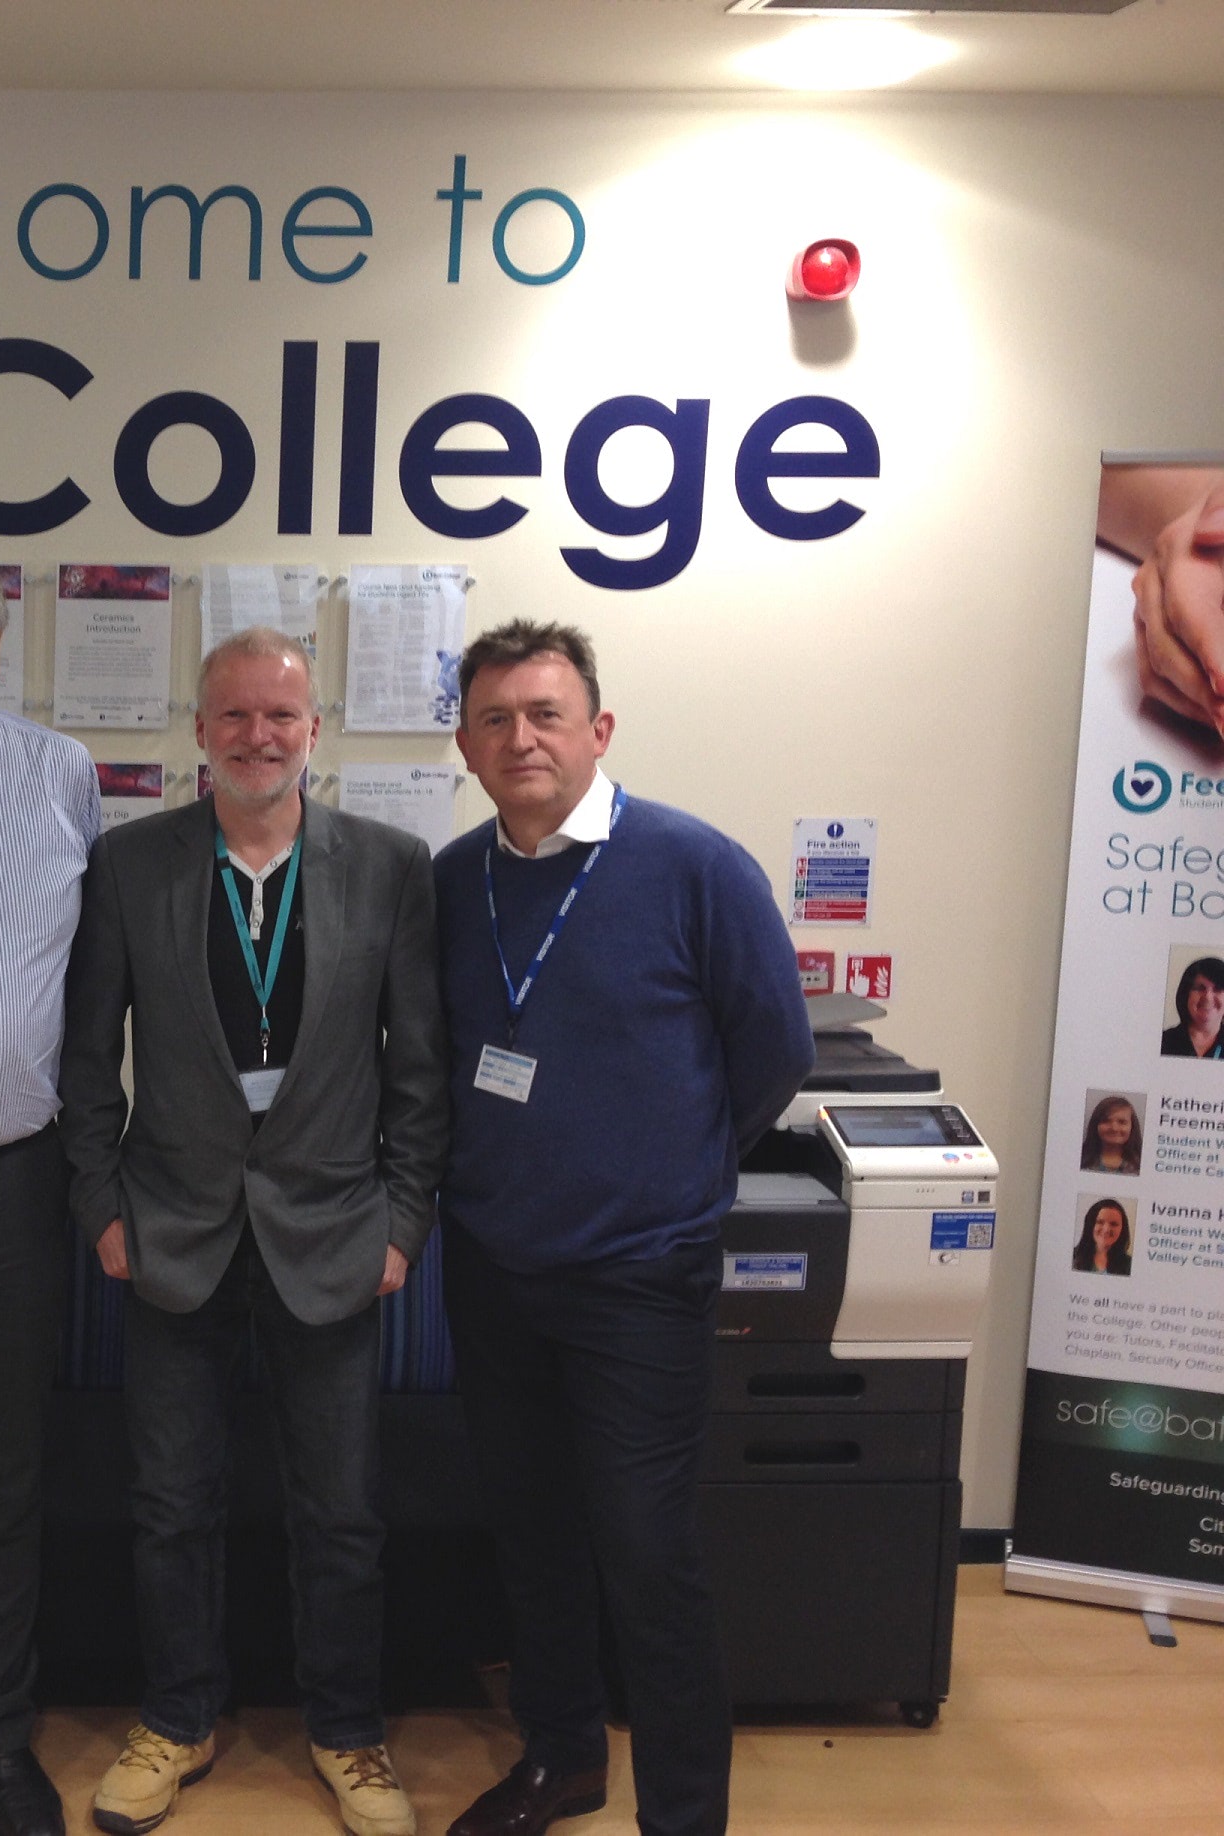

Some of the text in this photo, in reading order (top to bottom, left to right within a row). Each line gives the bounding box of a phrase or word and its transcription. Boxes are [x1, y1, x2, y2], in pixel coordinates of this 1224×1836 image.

[436, 154, 586, 286] to
[93, 613, 135, 622] Ceramics
[86, 625, 140, 633] Introduction
[1179, 798, 1223, 809] Student
[114, 811, 129, 819] Dip
[807, 840, 860, 849] Fire action
[1103, 880, 1224, 919] at Ba
[1160, 1113, 1224, 1131] Freema
[1158, 1135, 1210, 1148] Student
[1156, 1148, 1219, 1163] Officer at
[1155, 1161, 1201, 1175] Centre
[1152, 1202, 1211, 1220] Ivanna
[1149, 1223, 1203, 1237] Student
[1149, 1237, 1194, 1250] Officer
[1198, 1244, 1211, 1253] at
[1147, 1250, 1188, 1266] Valley
[1070, 1294, 1089, 1306] We
[1094, 1297, 1109, 1307] all
[1114, 1301, 1145, 1311] have
[1149, 1305, 1156, 1313] a
[1161, 1305, 1185, 1316] part
[1191, 1307, 1203, 1318] to
[1068, 1312, 1088, 1323] the
[1151, 1321, 1187, 1332] Other
[1066, 1330, 1089, 1341] you
[1129, 1352, 1181, 1369] Security
